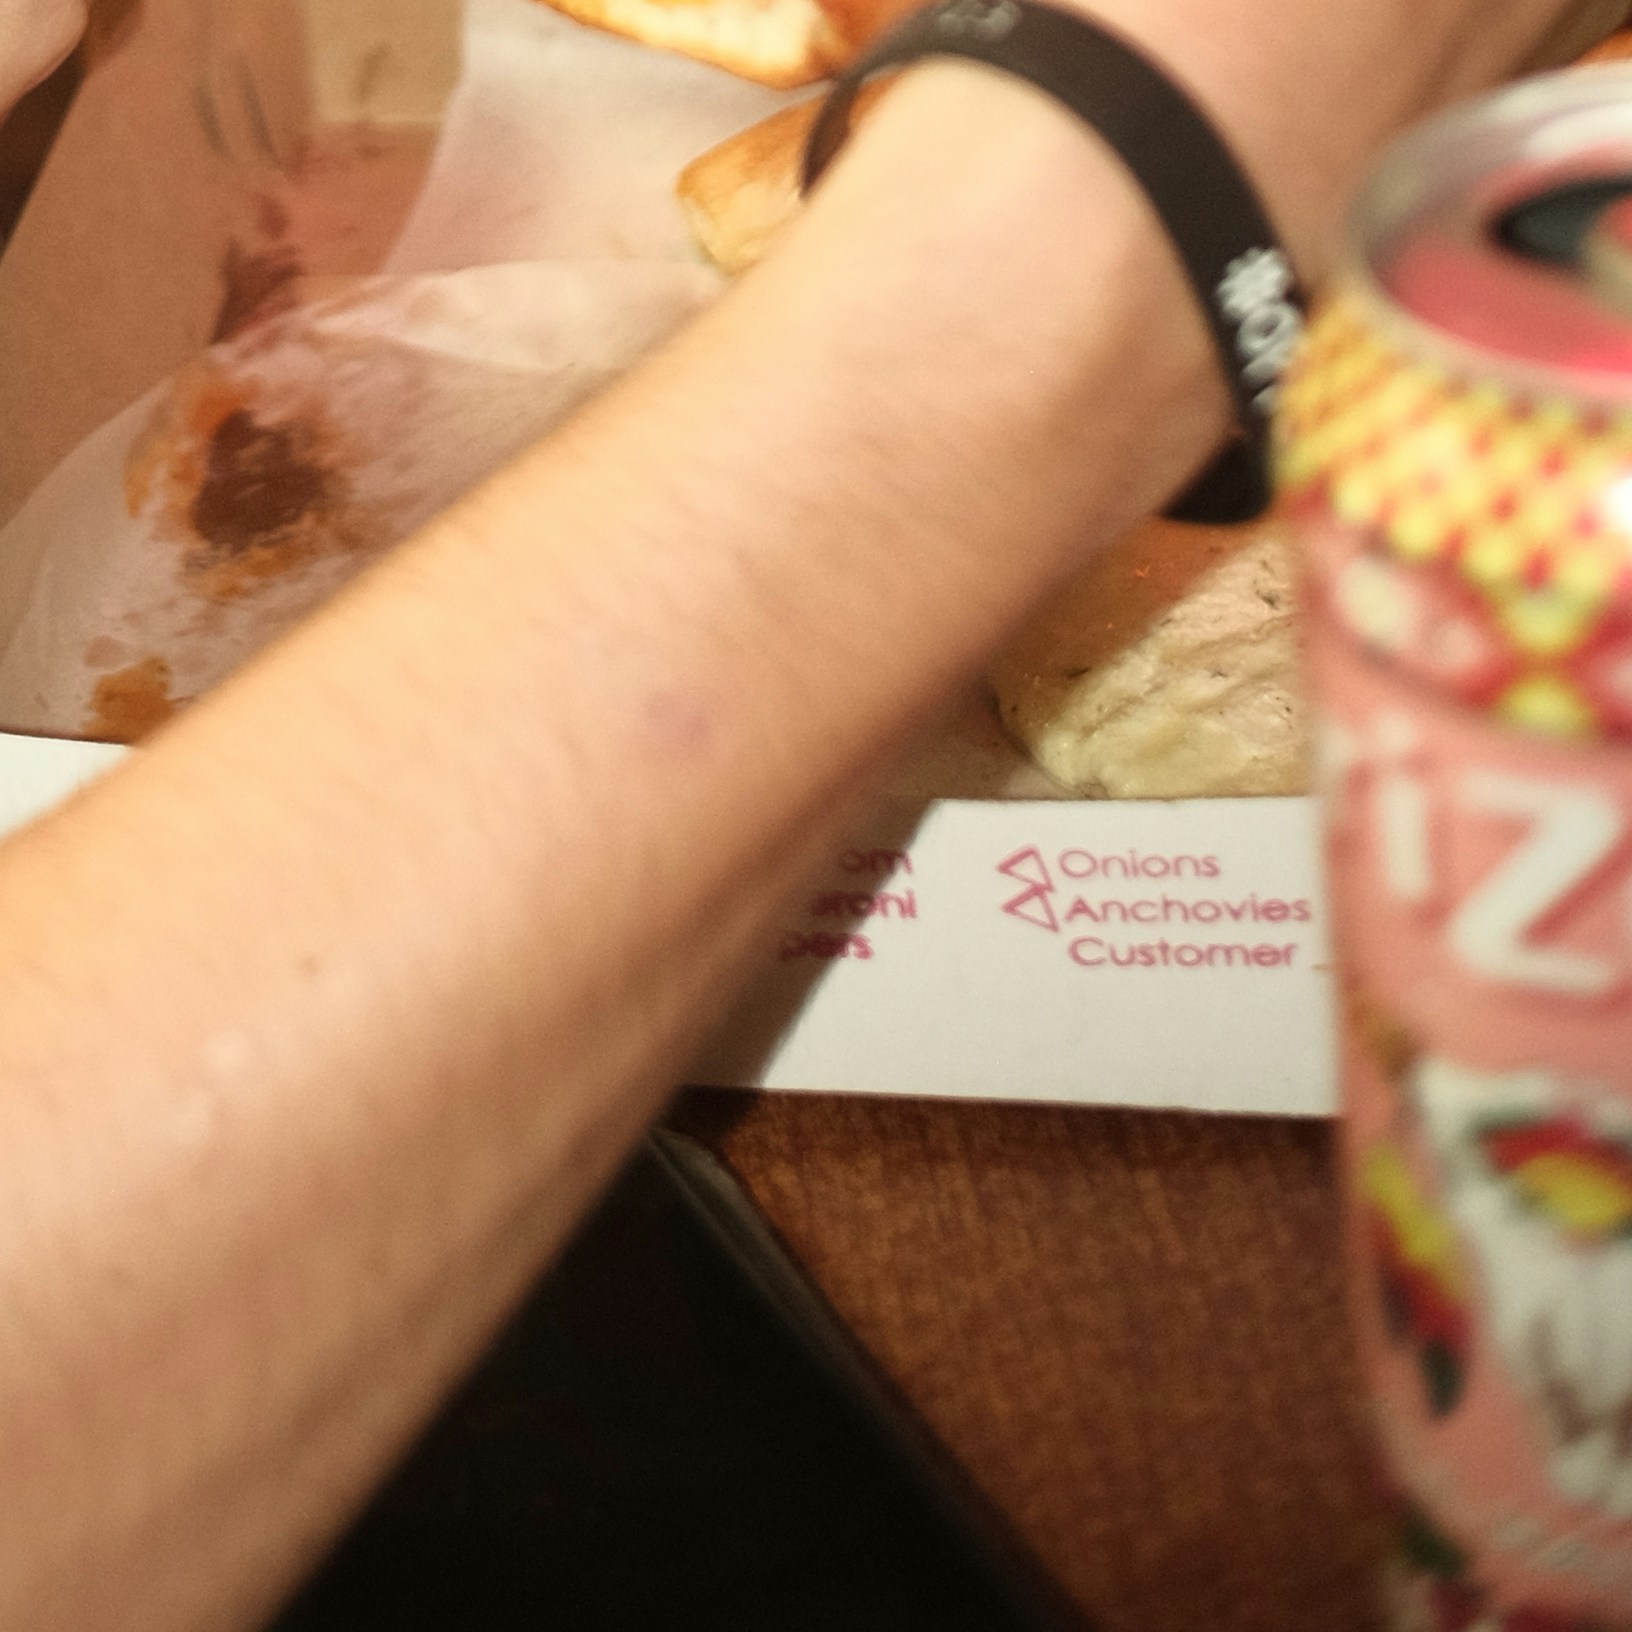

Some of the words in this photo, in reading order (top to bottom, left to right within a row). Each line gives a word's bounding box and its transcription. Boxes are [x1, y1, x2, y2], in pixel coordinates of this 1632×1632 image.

[1058, 847, 1221, 879] Onions
[1065, 892, 1313, 925] Anchovies
[1069, 935, 1298, 968] Customer
